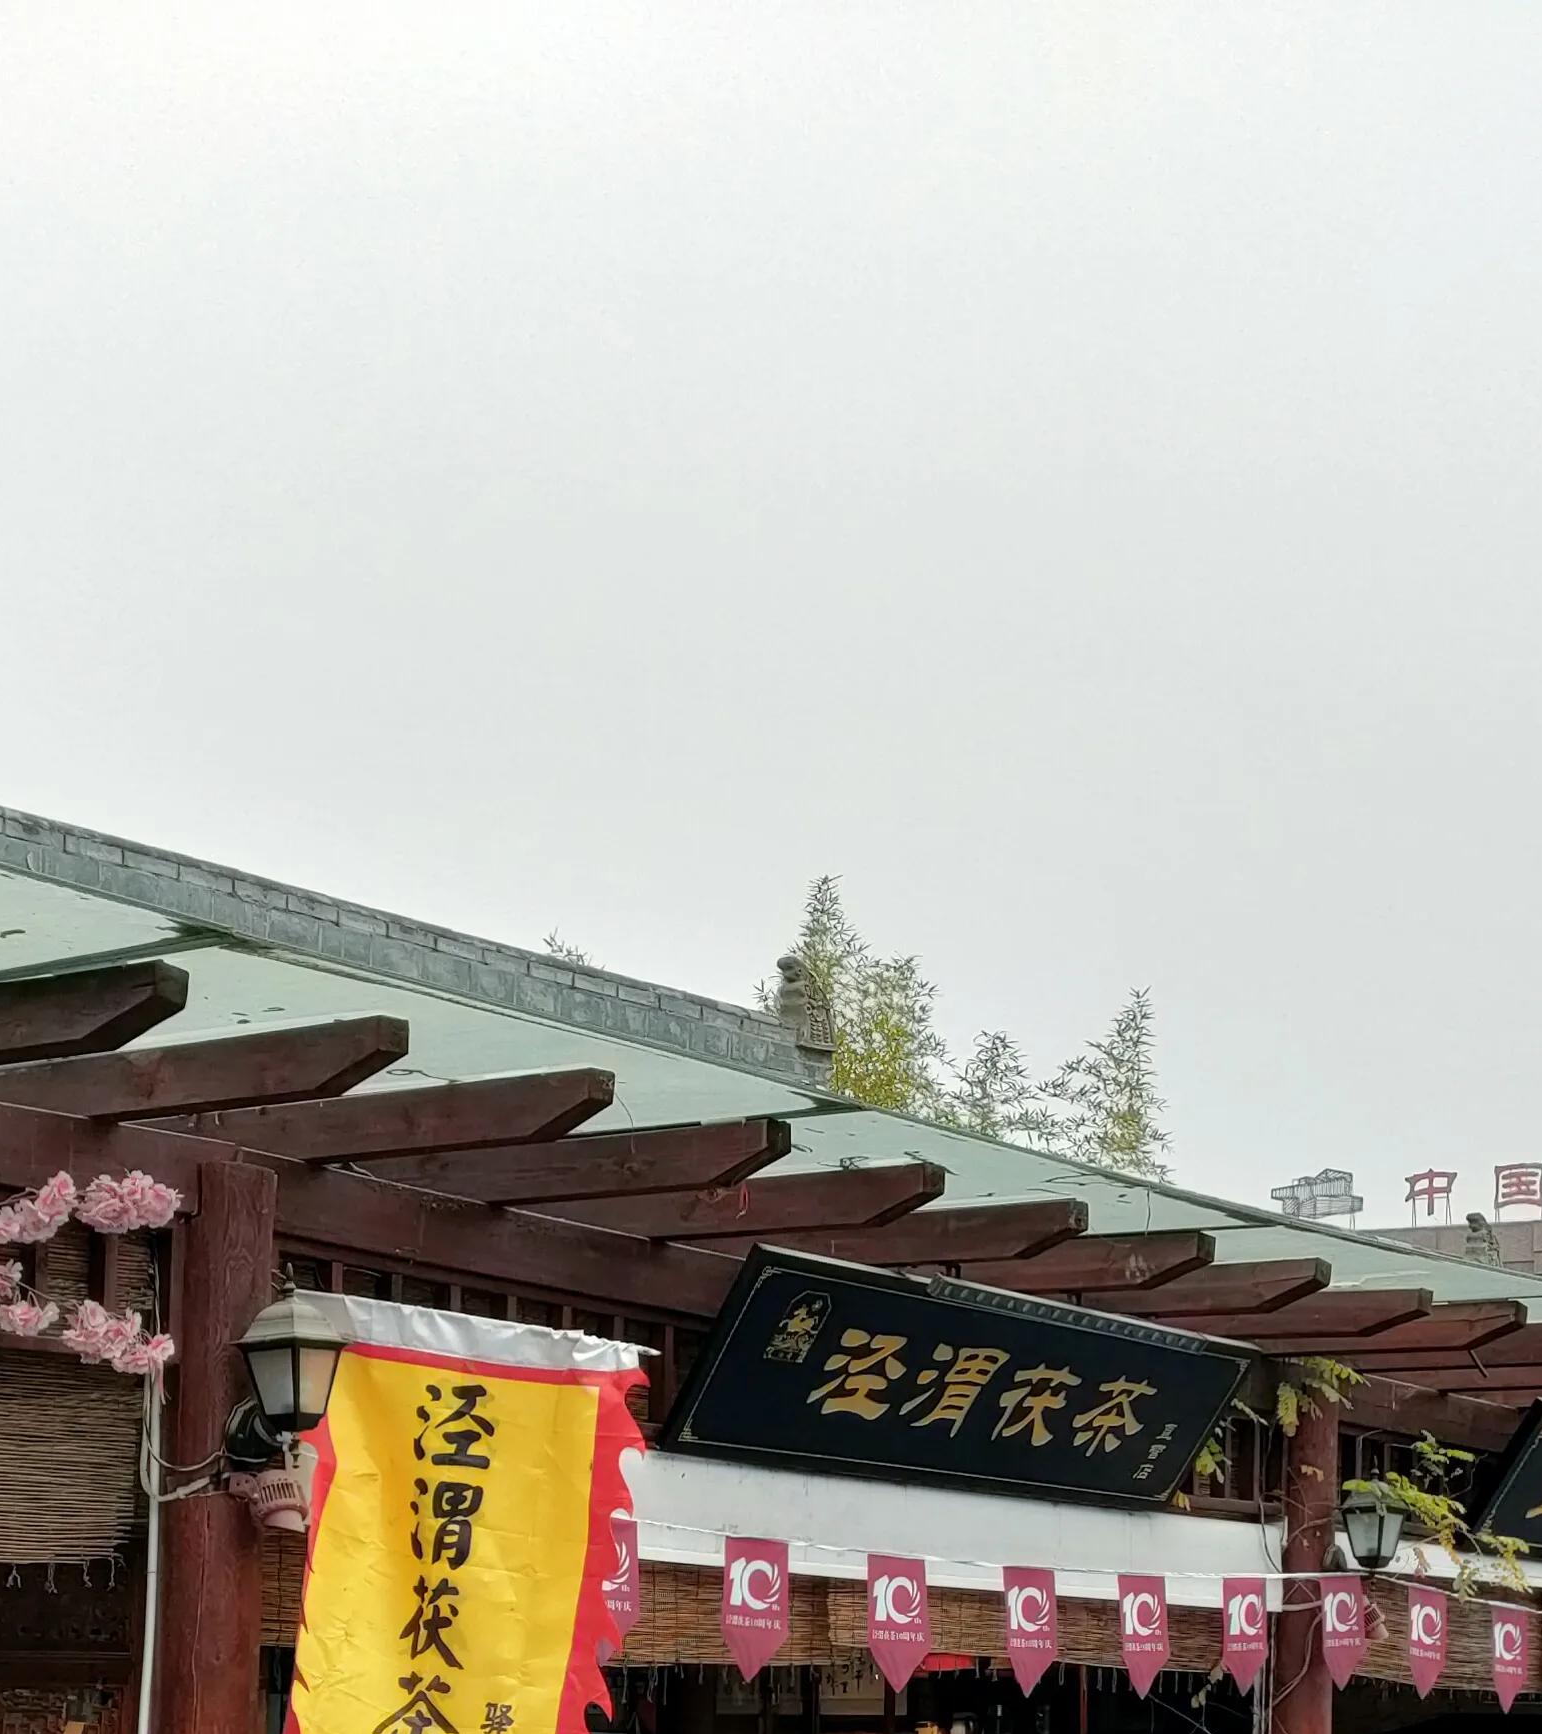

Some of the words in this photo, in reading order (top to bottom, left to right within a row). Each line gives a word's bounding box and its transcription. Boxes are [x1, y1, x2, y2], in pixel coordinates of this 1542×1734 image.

[806, 1327, 1157, 1457] 泾渭茯茶
[605, 1599, 632, 1612] 周年庆
